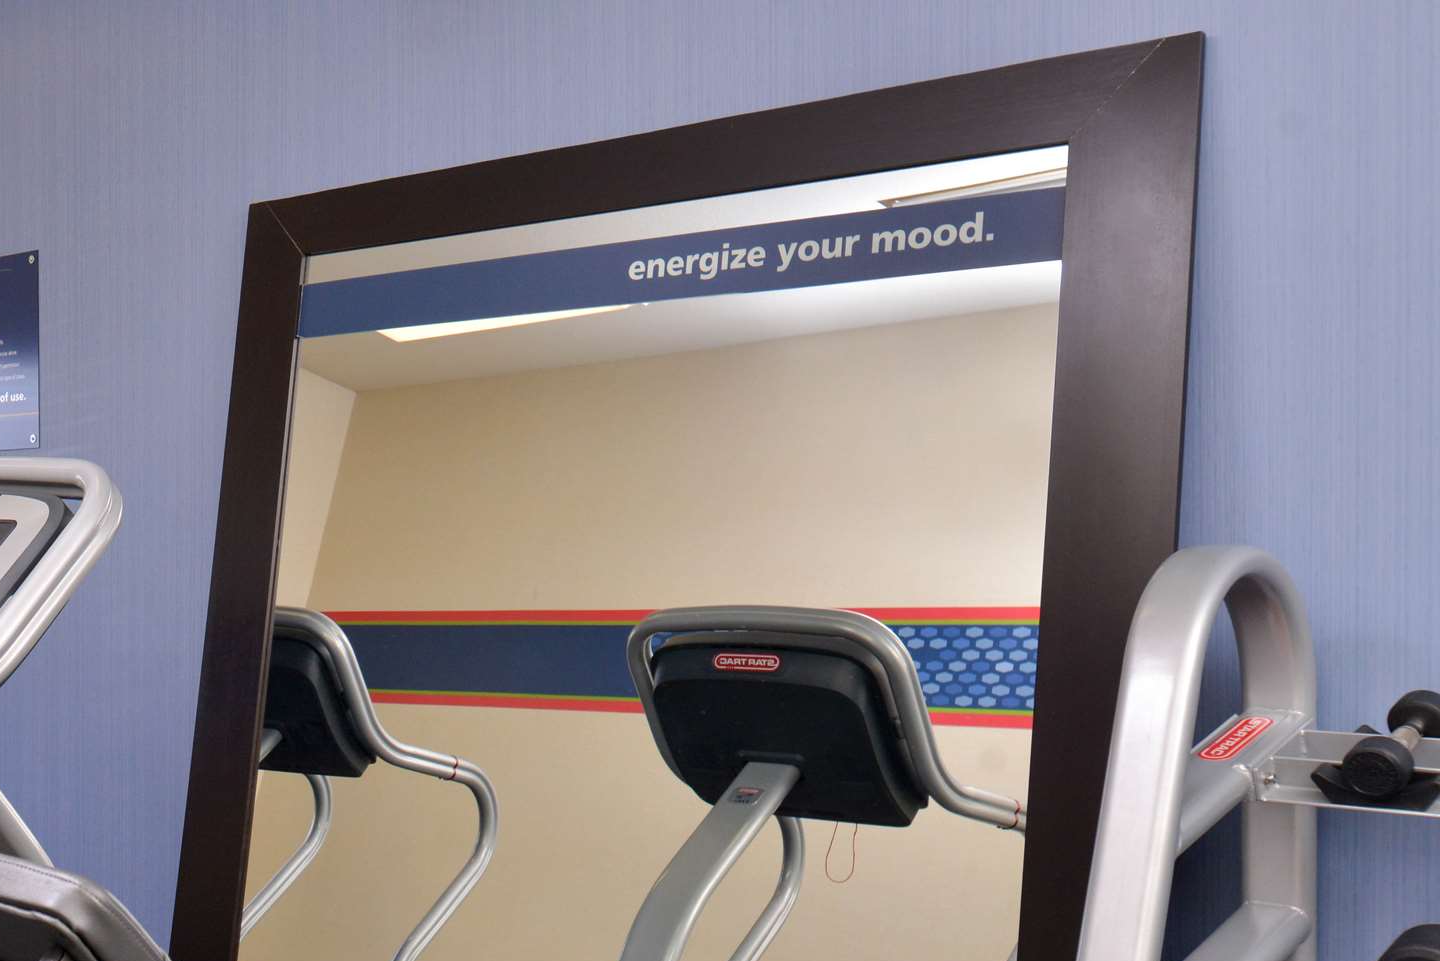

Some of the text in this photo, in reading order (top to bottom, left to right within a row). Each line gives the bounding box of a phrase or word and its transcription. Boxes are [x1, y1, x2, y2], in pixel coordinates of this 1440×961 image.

[627, 211, 994, 281] energize your mood.
[0, 391, 9, 403] of
[10, 392, 27, 402] use.
[1210, 719, 1262, 756] STAR TRAC
